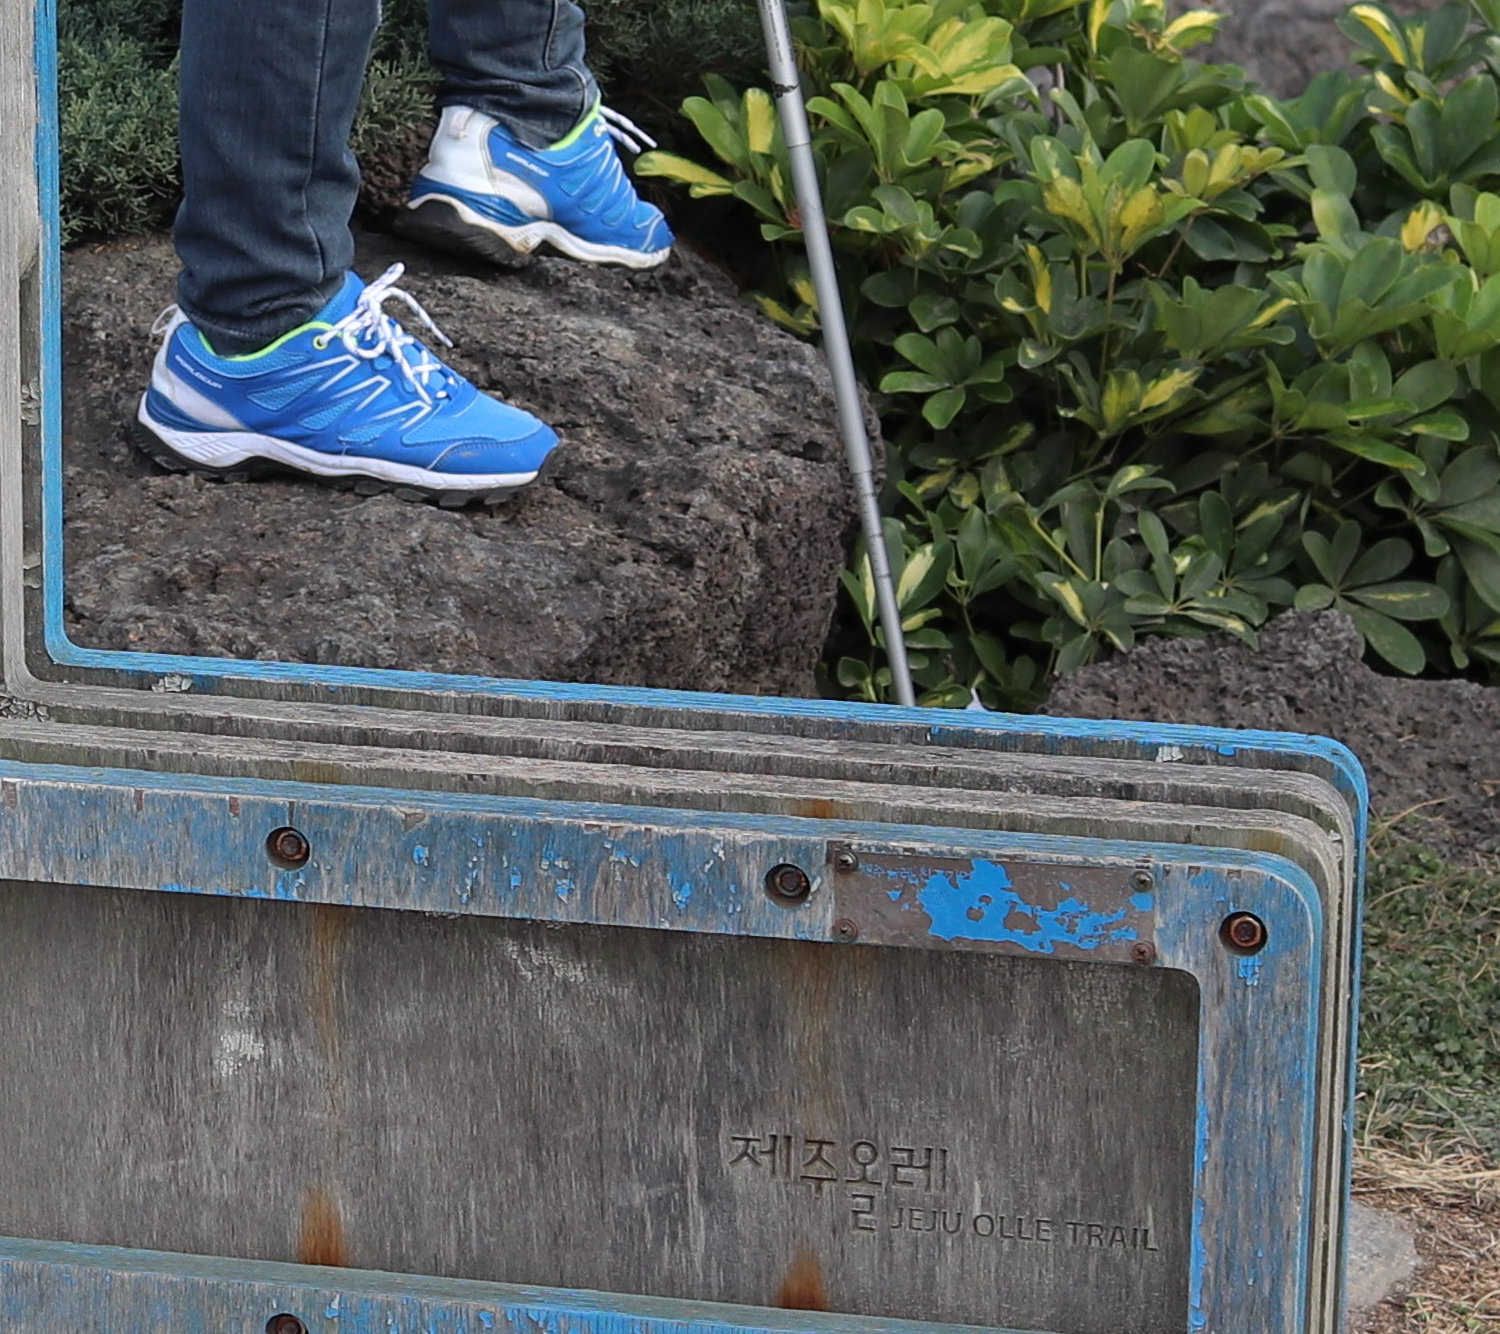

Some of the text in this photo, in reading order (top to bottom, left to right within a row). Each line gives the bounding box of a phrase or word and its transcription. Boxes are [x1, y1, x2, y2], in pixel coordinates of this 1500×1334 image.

[728, 1133, 949, 1234] 제주올레
[891, 1207, 1160, 1252] JEJU OLLE TRAIL
